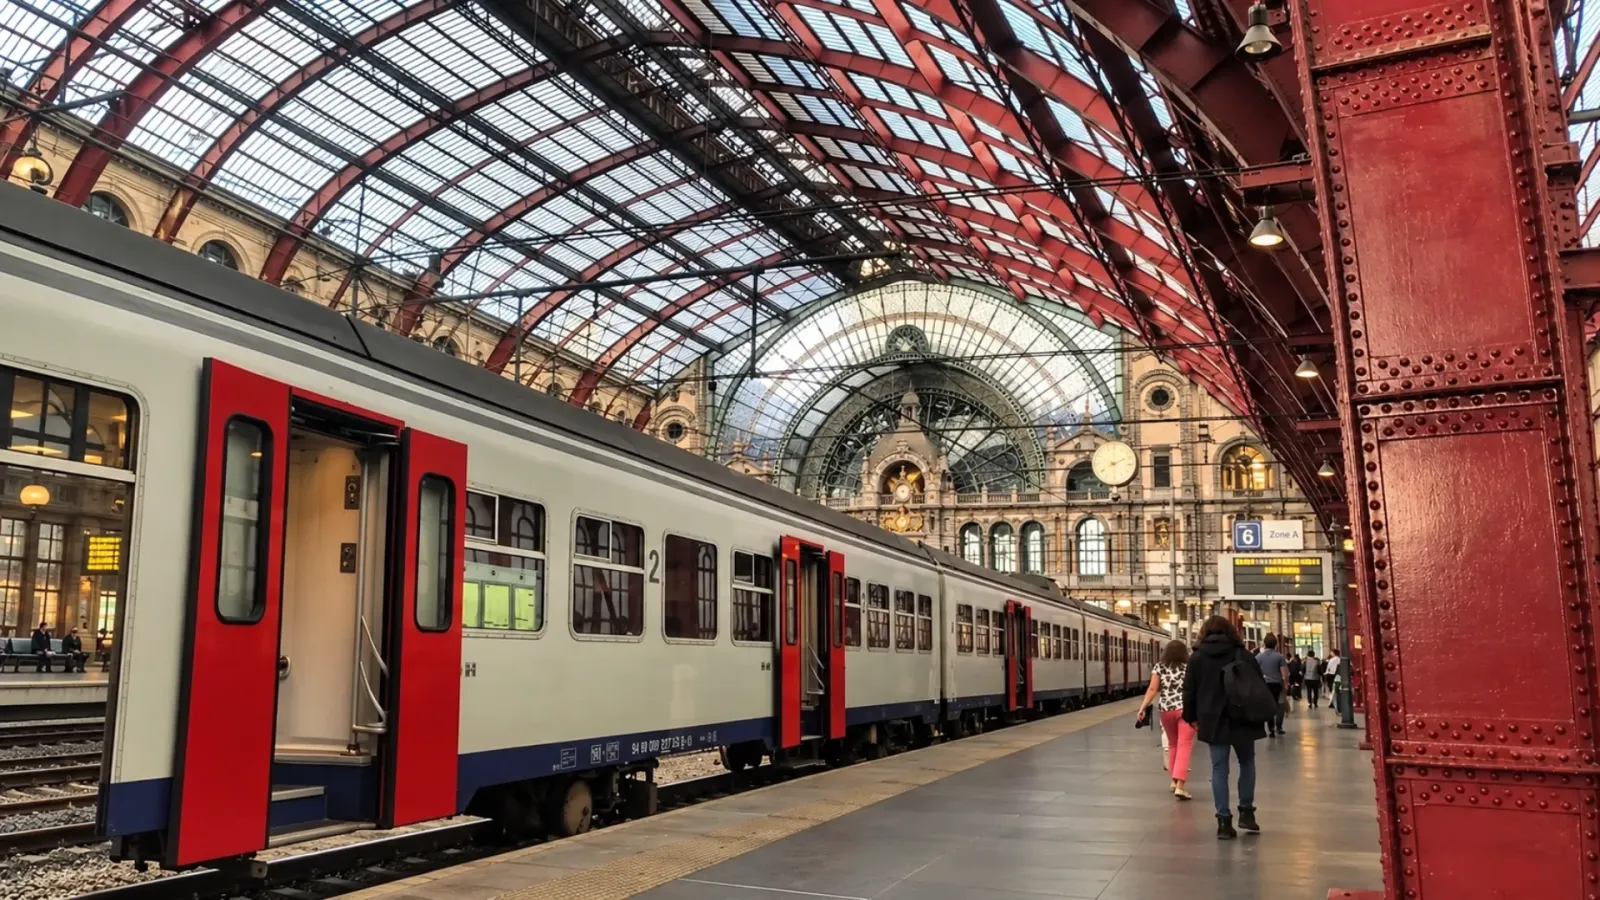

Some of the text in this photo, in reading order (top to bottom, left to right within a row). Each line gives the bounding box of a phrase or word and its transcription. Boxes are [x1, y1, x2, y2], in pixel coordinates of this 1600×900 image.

[1242, 529, 1254, 545] 6
[1269, 530, 1299, 539] Zone A
[649, 549, 660, 584] 2
